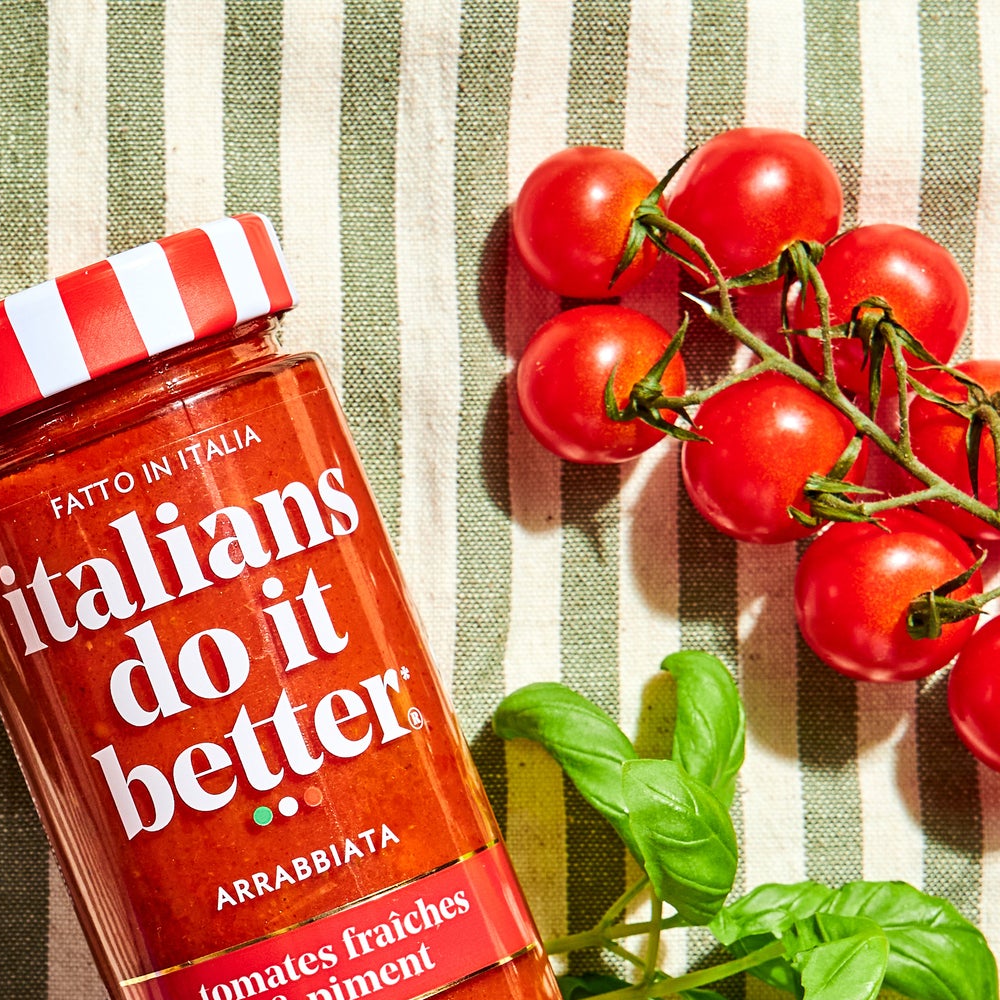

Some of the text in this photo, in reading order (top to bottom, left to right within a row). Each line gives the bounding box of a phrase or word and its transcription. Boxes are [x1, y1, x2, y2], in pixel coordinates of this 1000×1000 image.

[51, 425, 261, 519] FATTO IN ITALIA
[0, 468, 361, 655] italians
[109, 568, 349, 727] do it
[216, 824, 400, 910] ARRABBIATA
[341, 889, 471, 961] fraîches
